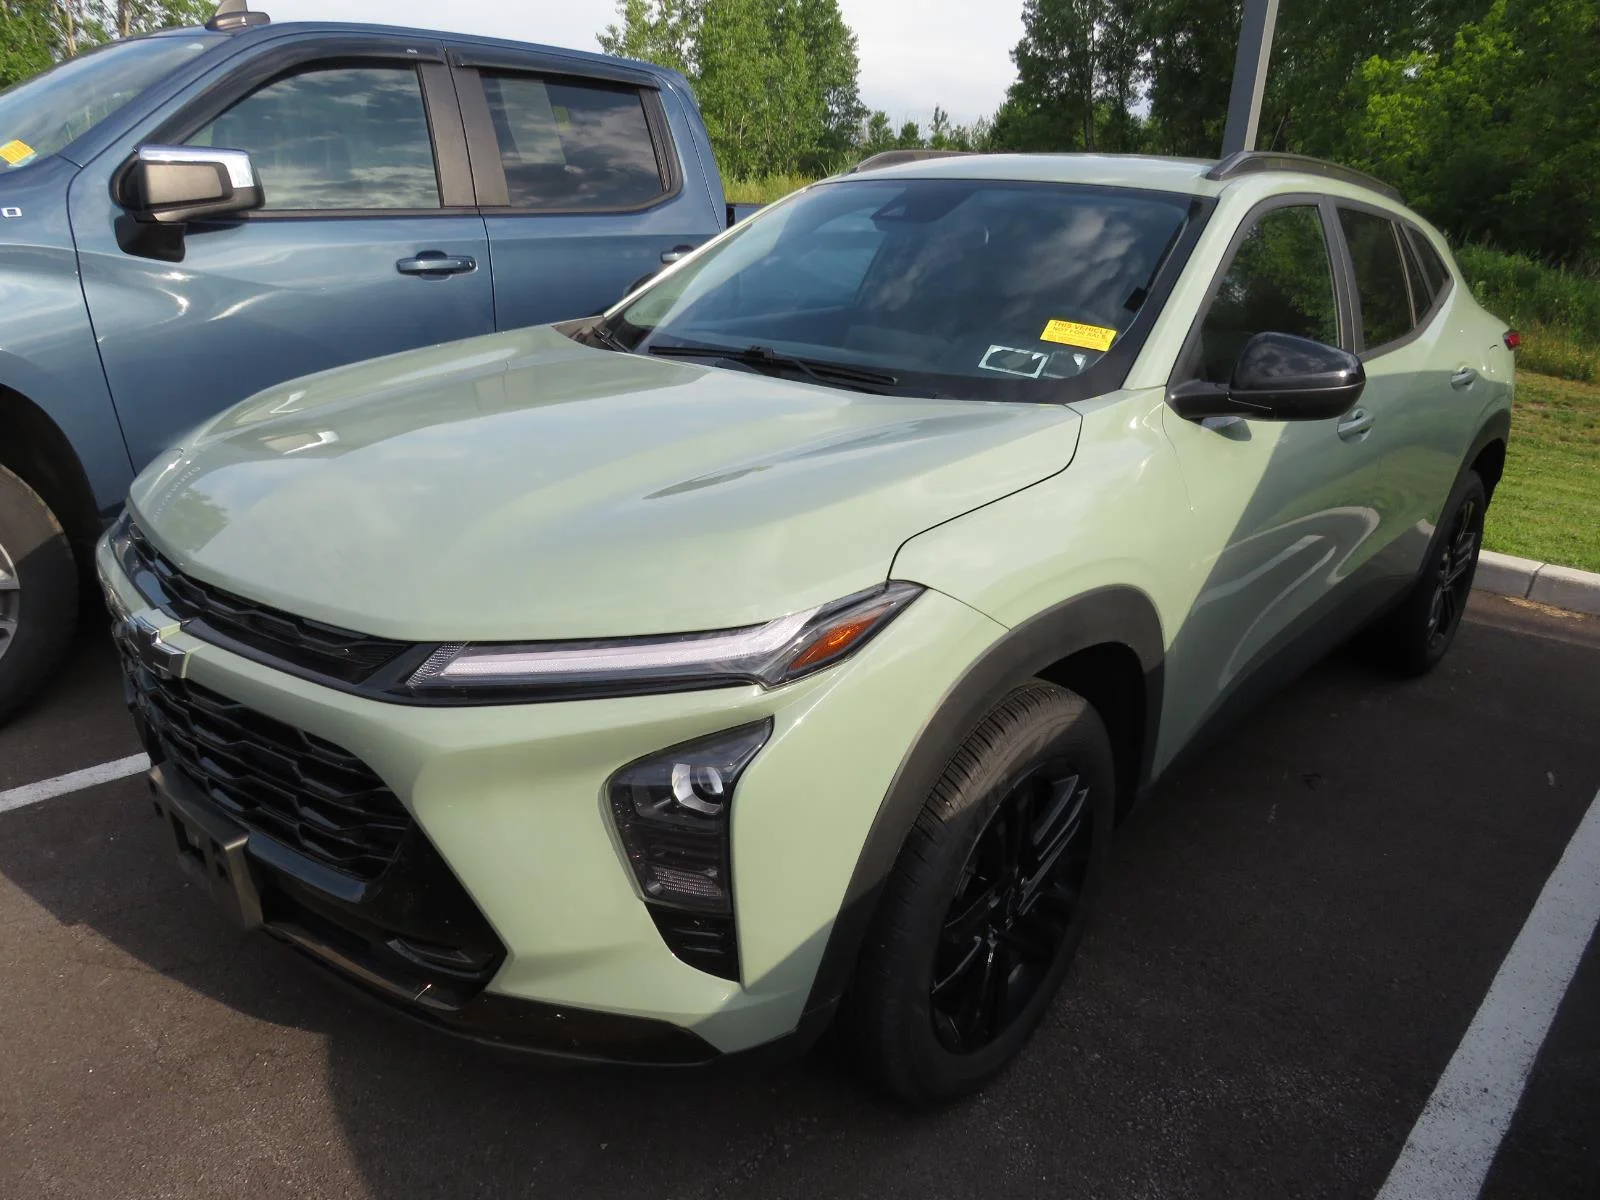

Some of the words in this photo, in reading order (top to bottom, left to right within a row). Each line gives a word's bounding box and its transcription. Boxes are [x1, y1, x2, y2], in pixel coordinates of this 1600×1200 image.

[1054, 321, 1072, 329] THIS
[1074, 324, 1111, 335] VEHICLE
[1069, 328, 1086, 336] FOR
[1087, 331, 1107, 340] SALE
